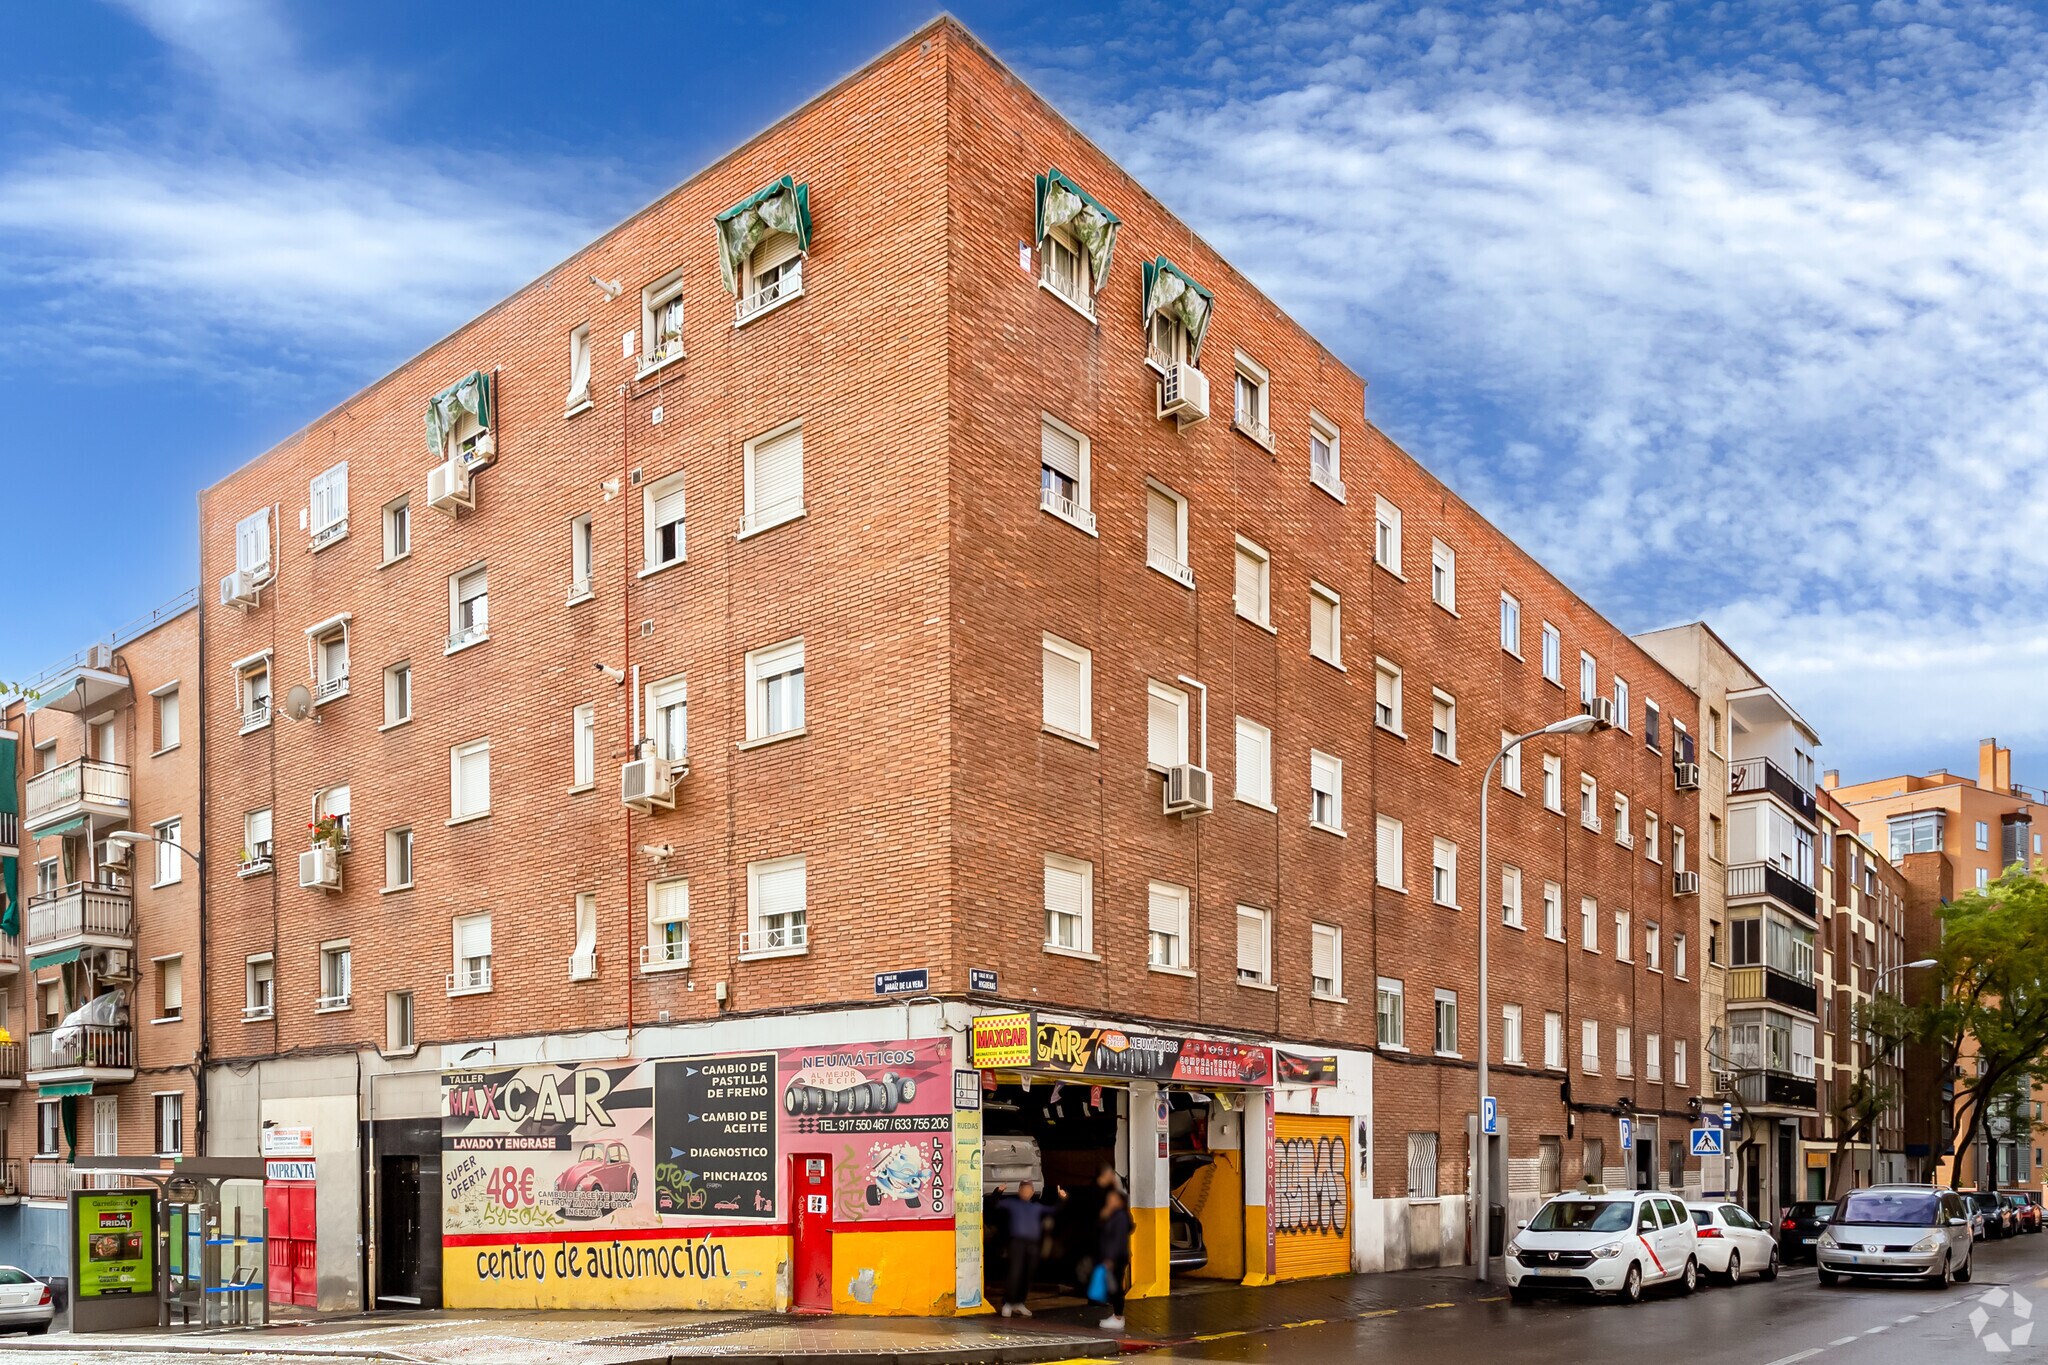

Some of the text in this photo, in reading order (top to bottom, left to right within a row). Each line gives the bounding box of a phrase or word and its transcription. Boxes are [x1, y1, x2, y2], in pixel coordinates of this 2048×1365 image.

[906, 981, 912, 989] LA
[912, 980, 923, 988] VERA
[976, 1028, 1028, 1048] MAXCAR
[1130, 1036, 1178, 1054] NEUMÁTICOS
[802, 1050, 916, 1068] NEUMÁTICOS
[702, 1062, 767, 1075] CAMBIO DE
[826, 1070, 856, 1078] MEJOR
[1181, 1065, 1192, 1074] DE
[450, 1074, 483, 1084] TALLER
[712, 1074, 768, 1086] PASTILLA
[811, 1077, 857, 1085] PRECIO
[449, 1068, 616, 1127] MAX CAR
[707, 1086, 768, 1098] DE FRENO
[701, 1111, 767, 1122] CAMBIO DE
[724, 1124, 767, 1133] ACEITE
[819, 1120, 838, 1131] TEL:
[839, 1120, 855, 1130] 917
[856, 1120, 872, 1130] 550
[873, 1119, 890, 1130] 467
[894, 1119, 911, 1129] 633
[913, 1118, 929, 1129] 755
[931, 1118, 948, 1129] 206
[453, 1137, 556, 1149] LAVADO Y ENGRASE
[690, 1148, 768, 1157] DIAGNOSTICO
[268, 1164, 315, 1178] IMPRENTA
[446, 1155, 477, 1186] SUPER
[703, 1172, 767, 1181] PINCHAZOS
[932, 1137, 944, 1212] LAVADO
[451, 1166, 487, 1199] OFERTA
[486, 1166, 535, 1209] 48€
[538, 1190, 566, 1198] CAMBIO
[582, 1191, 609, 1199] ACEITE
[573, 1200, 597, 1208] MANO
[565, 1208, 603, 1217] INCLUIDA
[100, 1220, 131, 1230] FRIDAY
[477, 1232, 730, 1283] centro de automoción
